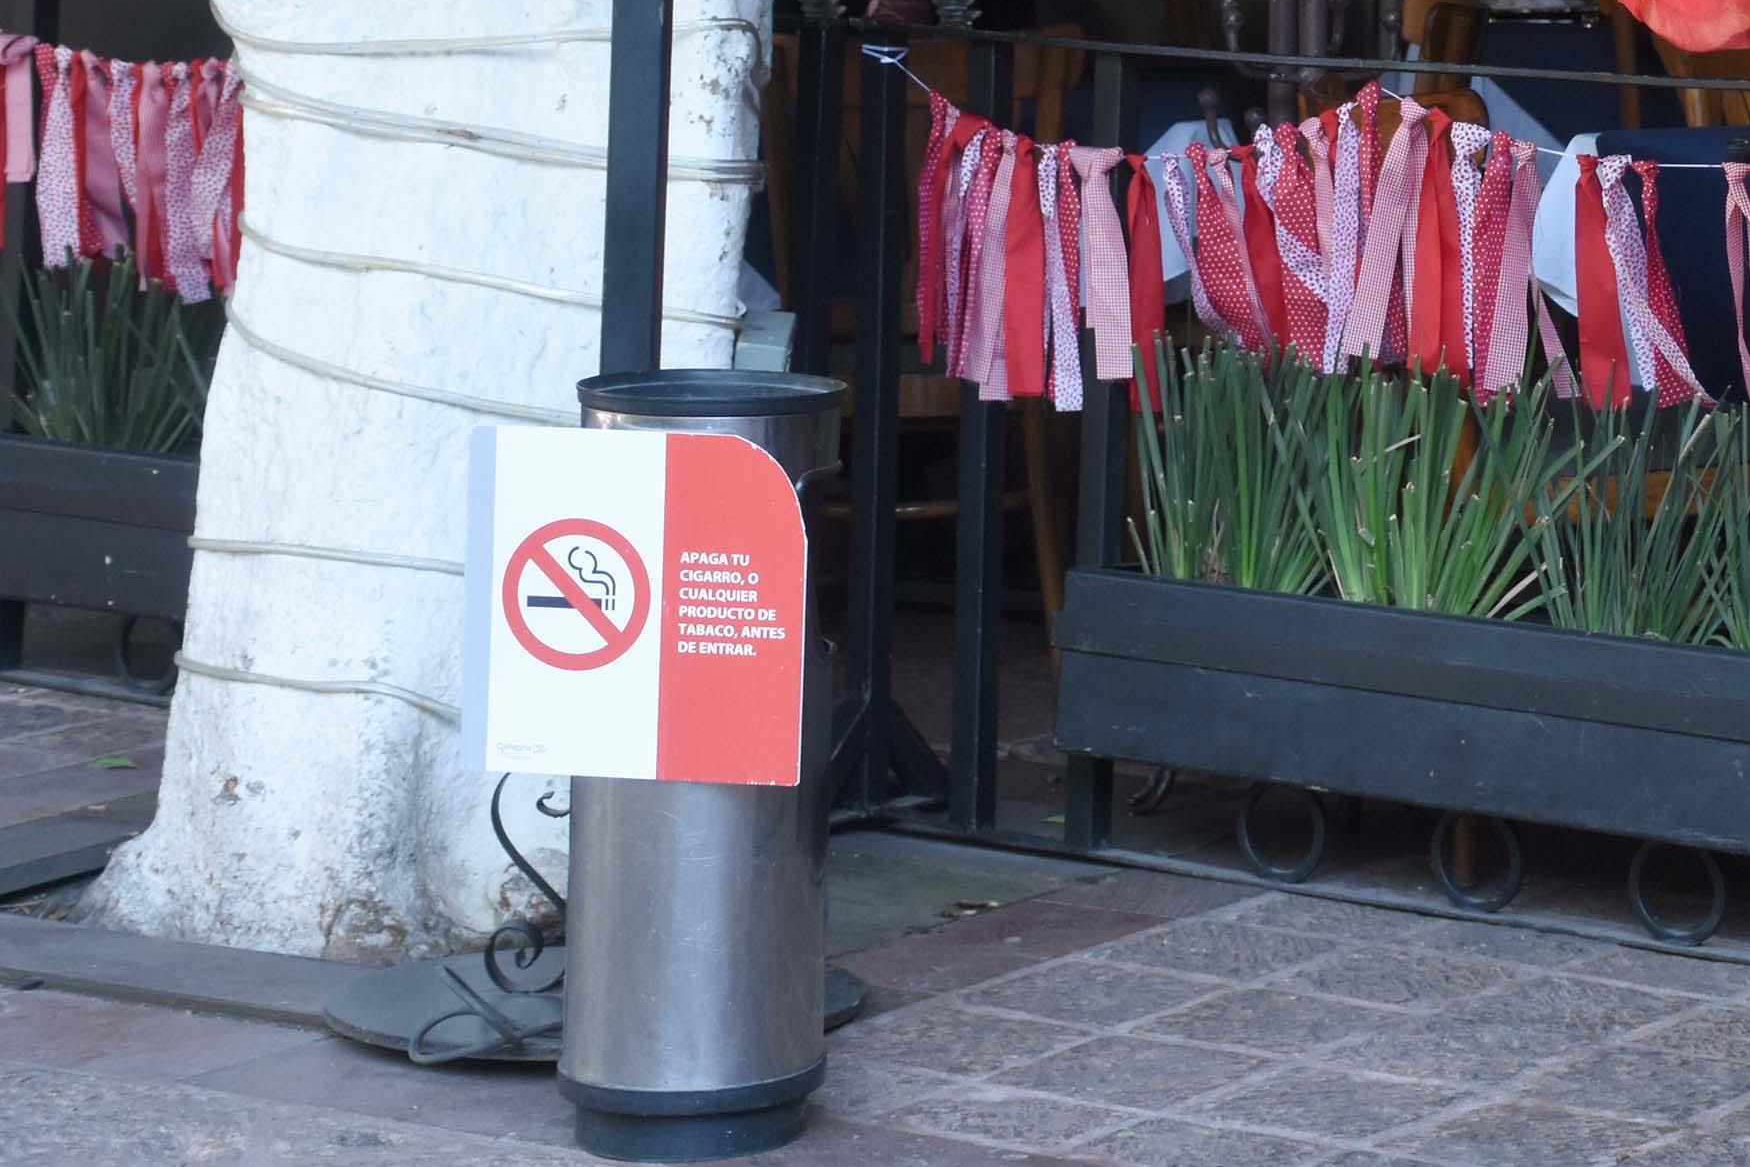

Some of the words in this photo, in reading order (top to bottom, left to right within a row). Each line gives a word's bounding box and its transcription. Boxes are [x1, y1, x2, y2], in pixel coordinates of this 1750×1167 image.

[680, 551, 728, 565] APAGA
[731, 554, 750, 566] TU
[679, 569, 745, 585] CIGARRO,
[747, 572, 759, 585] O
[679, 587, 758, 603] CUALQUIER
[678, 605, 755, 620] PRODUCTO
[757, 609, 777, 621] DE
[678, 623, 738, 638] TABACO,
[741, 626, 786, 640] ANTES
[677, 641, 697, 654] DE
[699, 642, 757, 656] ENTRAR.
